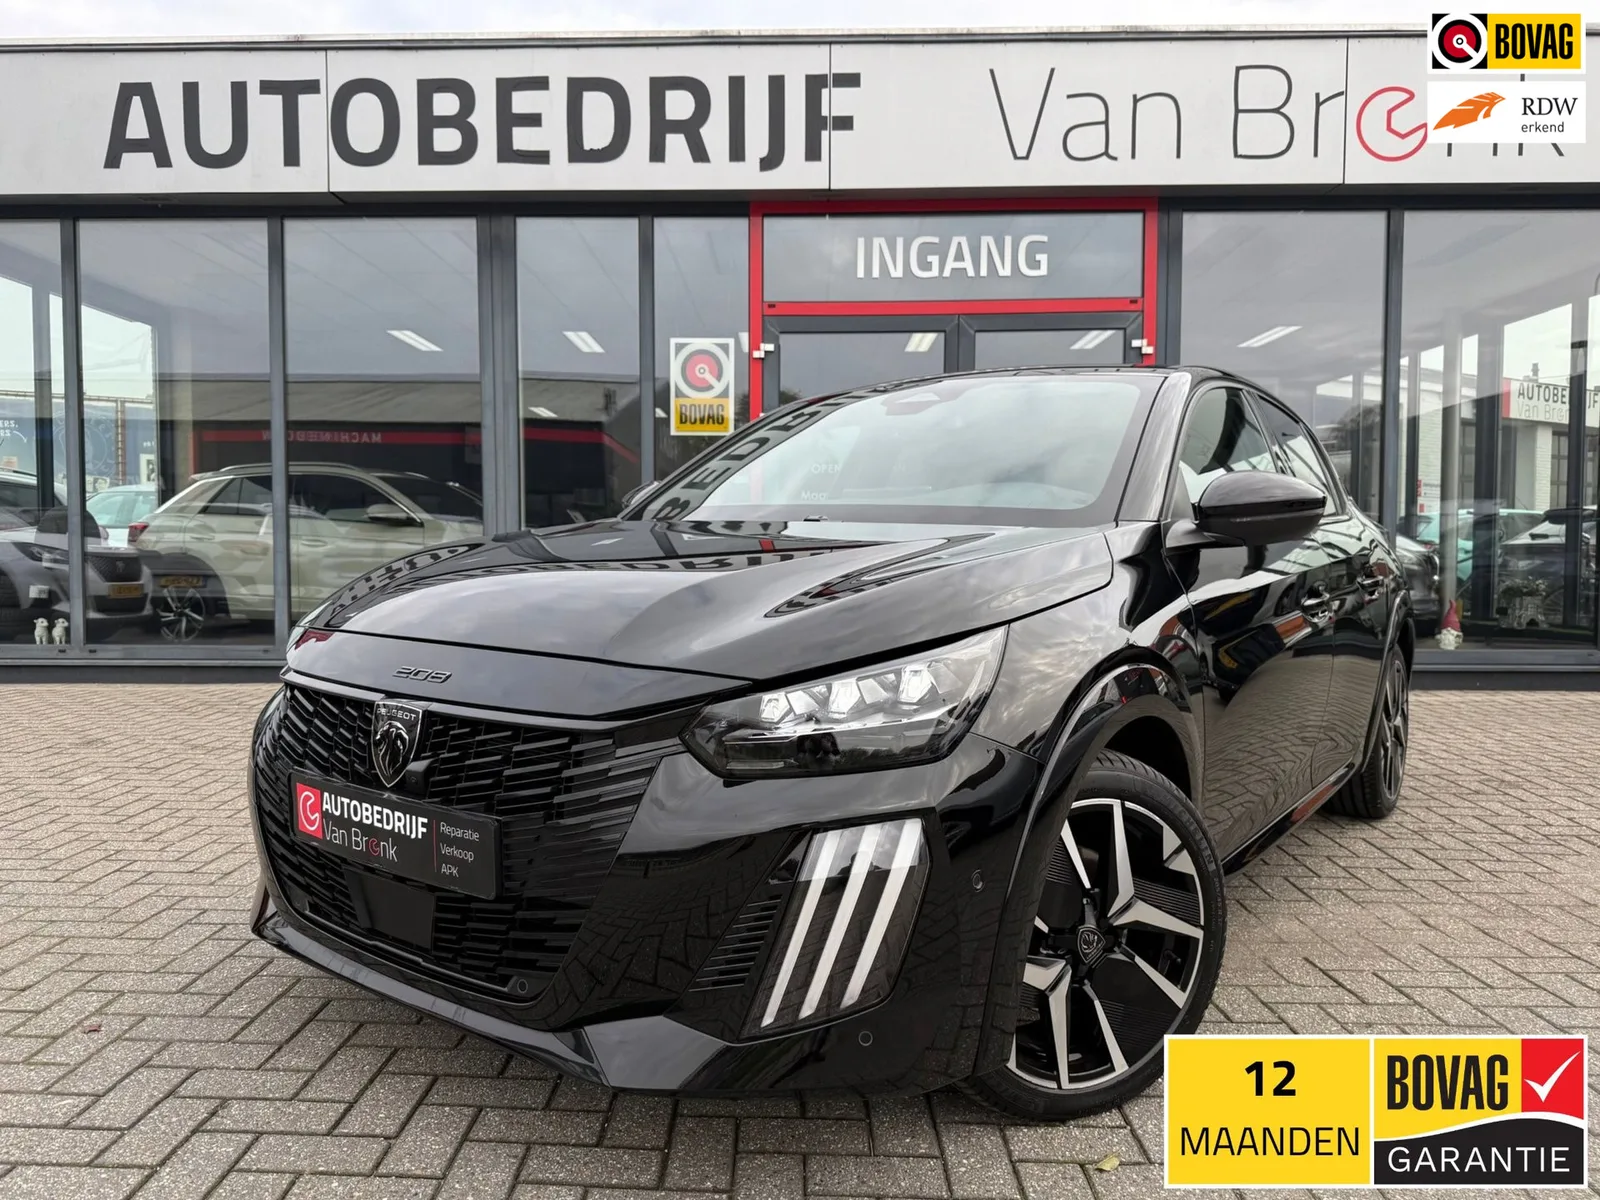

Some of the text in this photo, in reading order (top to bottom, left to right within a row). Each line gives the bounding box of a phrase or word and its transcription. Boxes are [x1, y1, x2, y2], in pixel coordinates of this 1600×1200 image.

[102, 71, 862, 173] AUTOBEDRIJF
[988, 66, 1182, 162] Van
[856, 234, 1049, 279] INGANG
[1517, 382, 1599, 410] AUTOBEJF
[679, 403, 725, 426] BOVAG
[1516, 401, 1570, 422] Van Bren
[392, 665, 452, 684] 208
[376, 707, 417, 721] PEUGEOT
[322, 791, 428, 839] AUTOBEDRIJF
[322, 818, 348, 847] Van
[439, 821, 480, 842] Reparatie
[439, 843, 475, 864] Verkoop
[441, 863, 459, 878] APK
